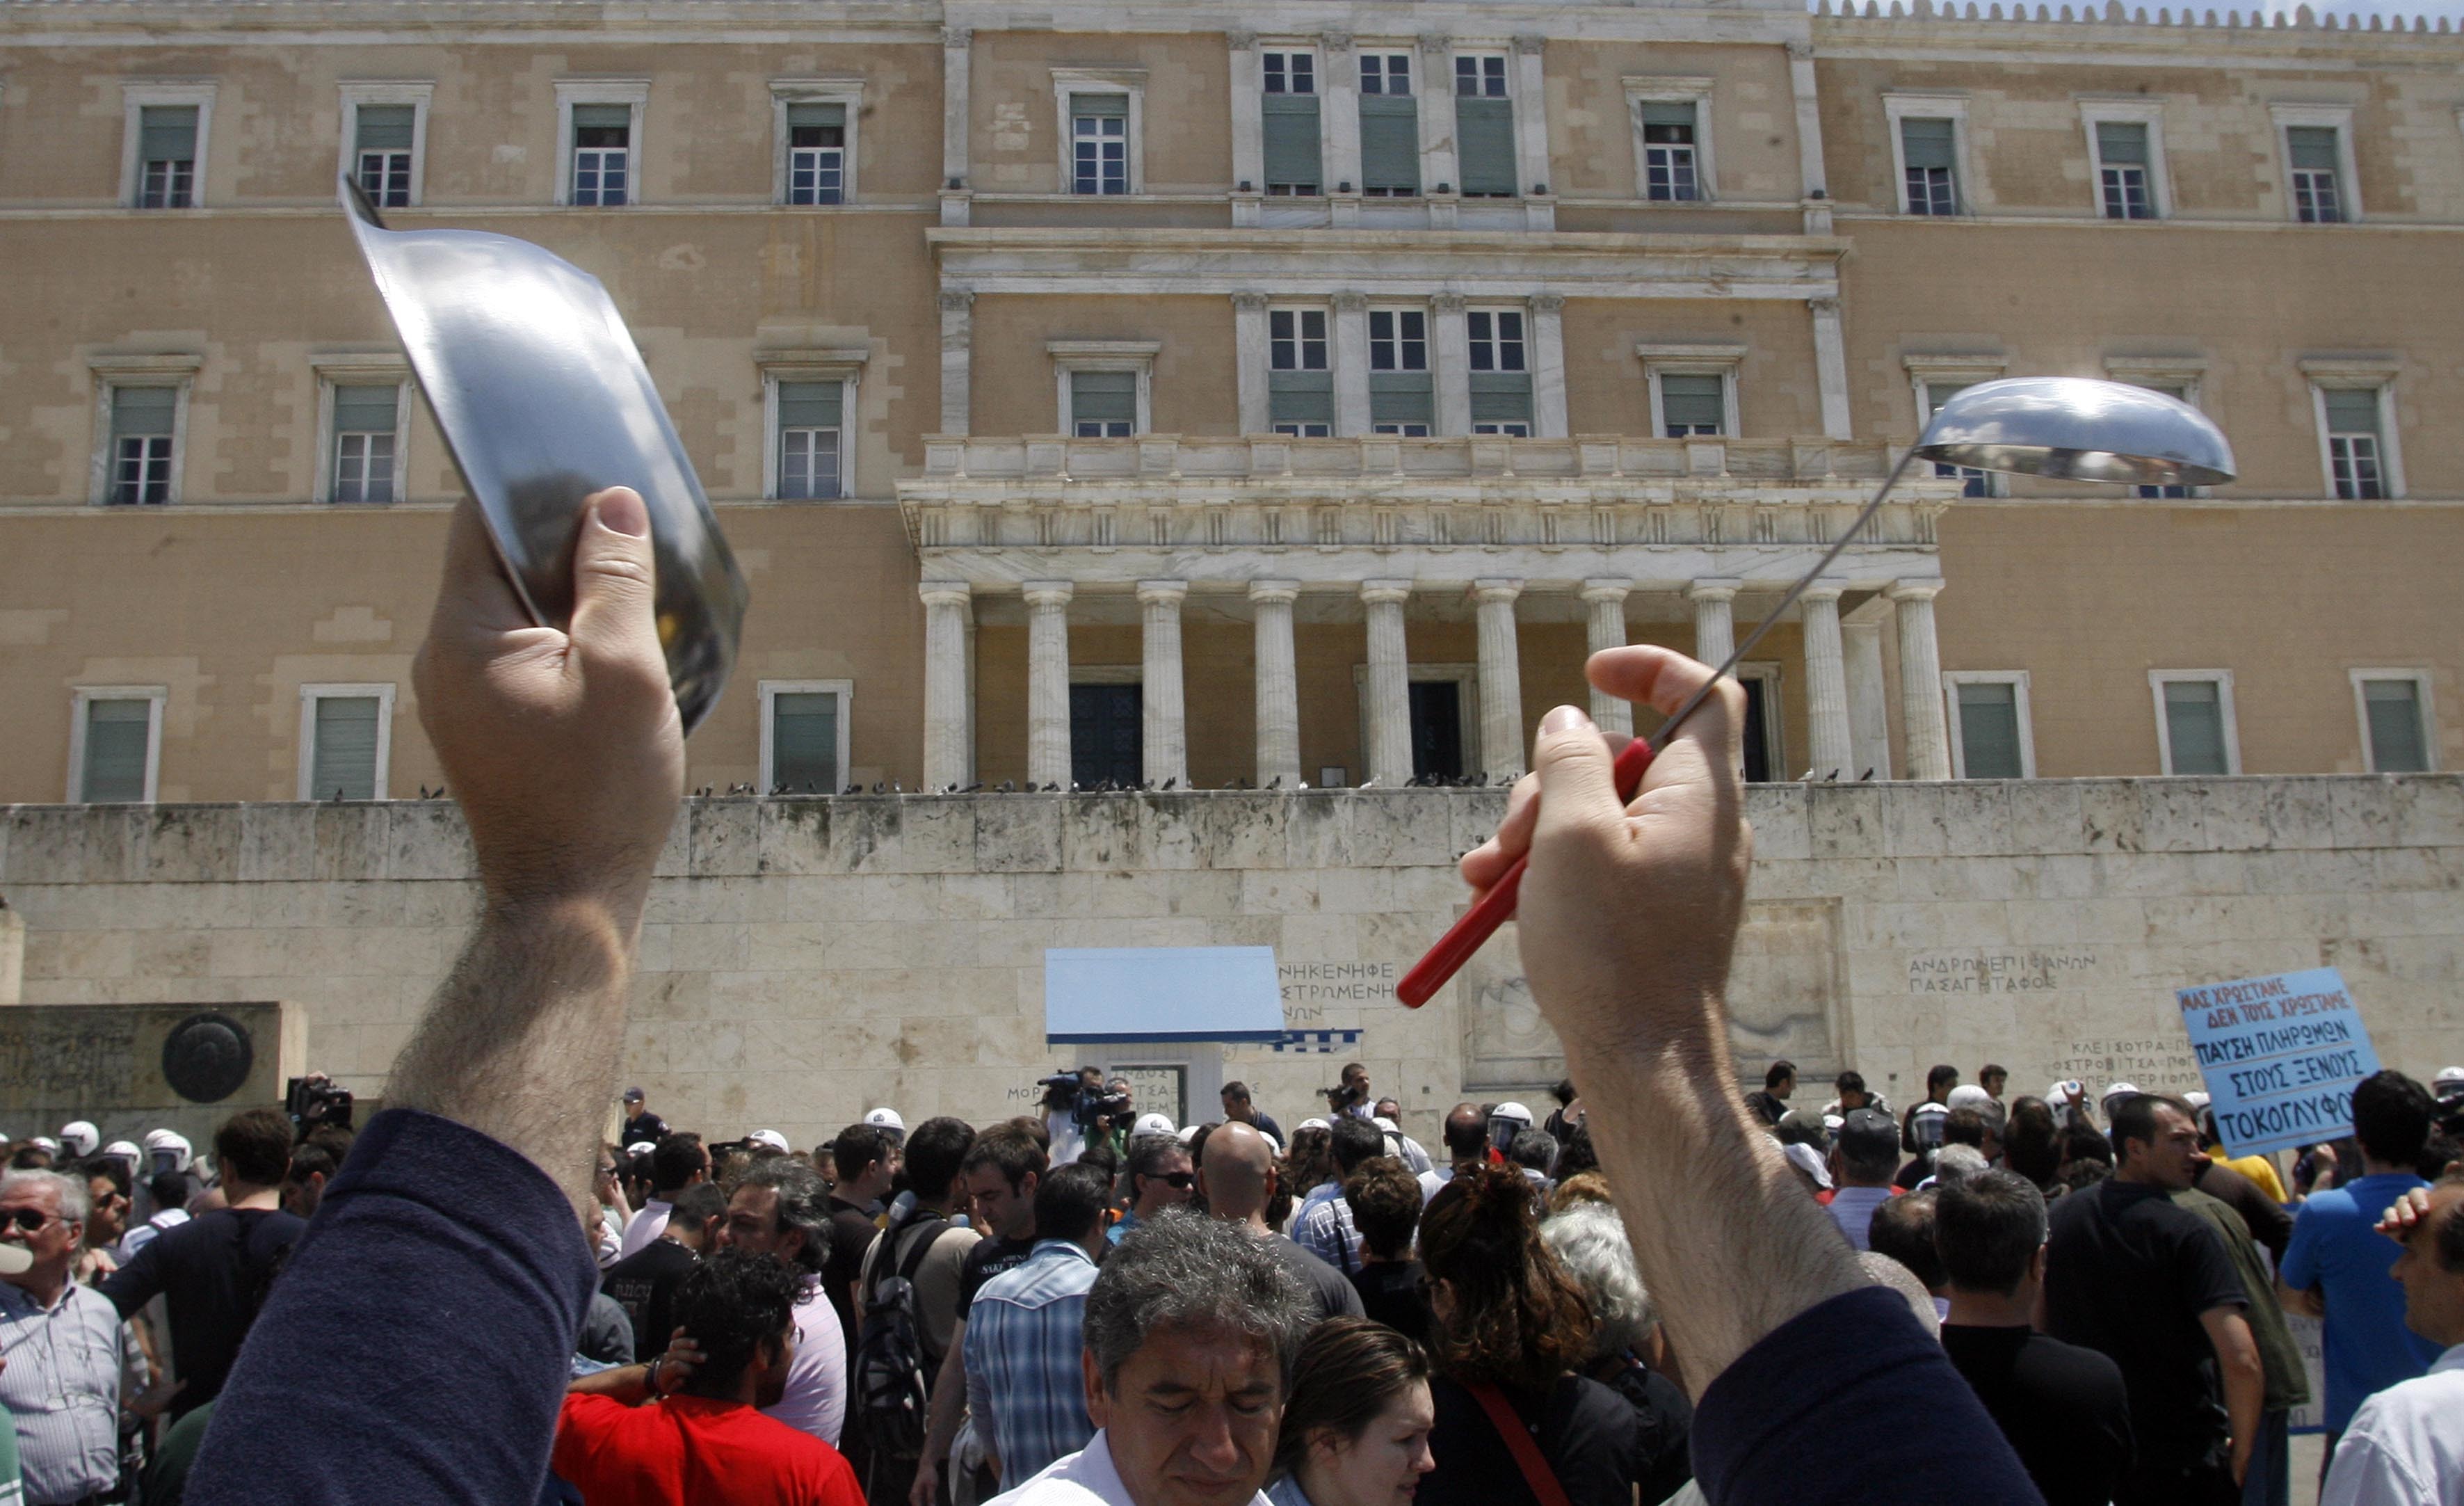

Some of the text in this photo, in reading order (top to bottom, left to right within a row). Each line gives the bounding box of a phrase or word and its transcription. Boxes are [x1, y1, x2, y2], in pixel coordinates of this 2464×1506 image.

[2181, 990, 2212, 1011] ΜΑΣ
[2207, 1007, 2240, 1029] ΔΕΝ
[2239, 1001, 2276, 1023] ΤΟΥΣ
[2193, 1020, 2350, 1065] ΠΑΥΣΗ ΠΛΗΡΩΜΩΝ
[2230, 1050, 2364, 1097] ΣΤΟΥΣ ΞΕΝΟΥΣ
[2220, 1091, 2355, 1141] ΤΟΚΟΓΛΥΦΟ
